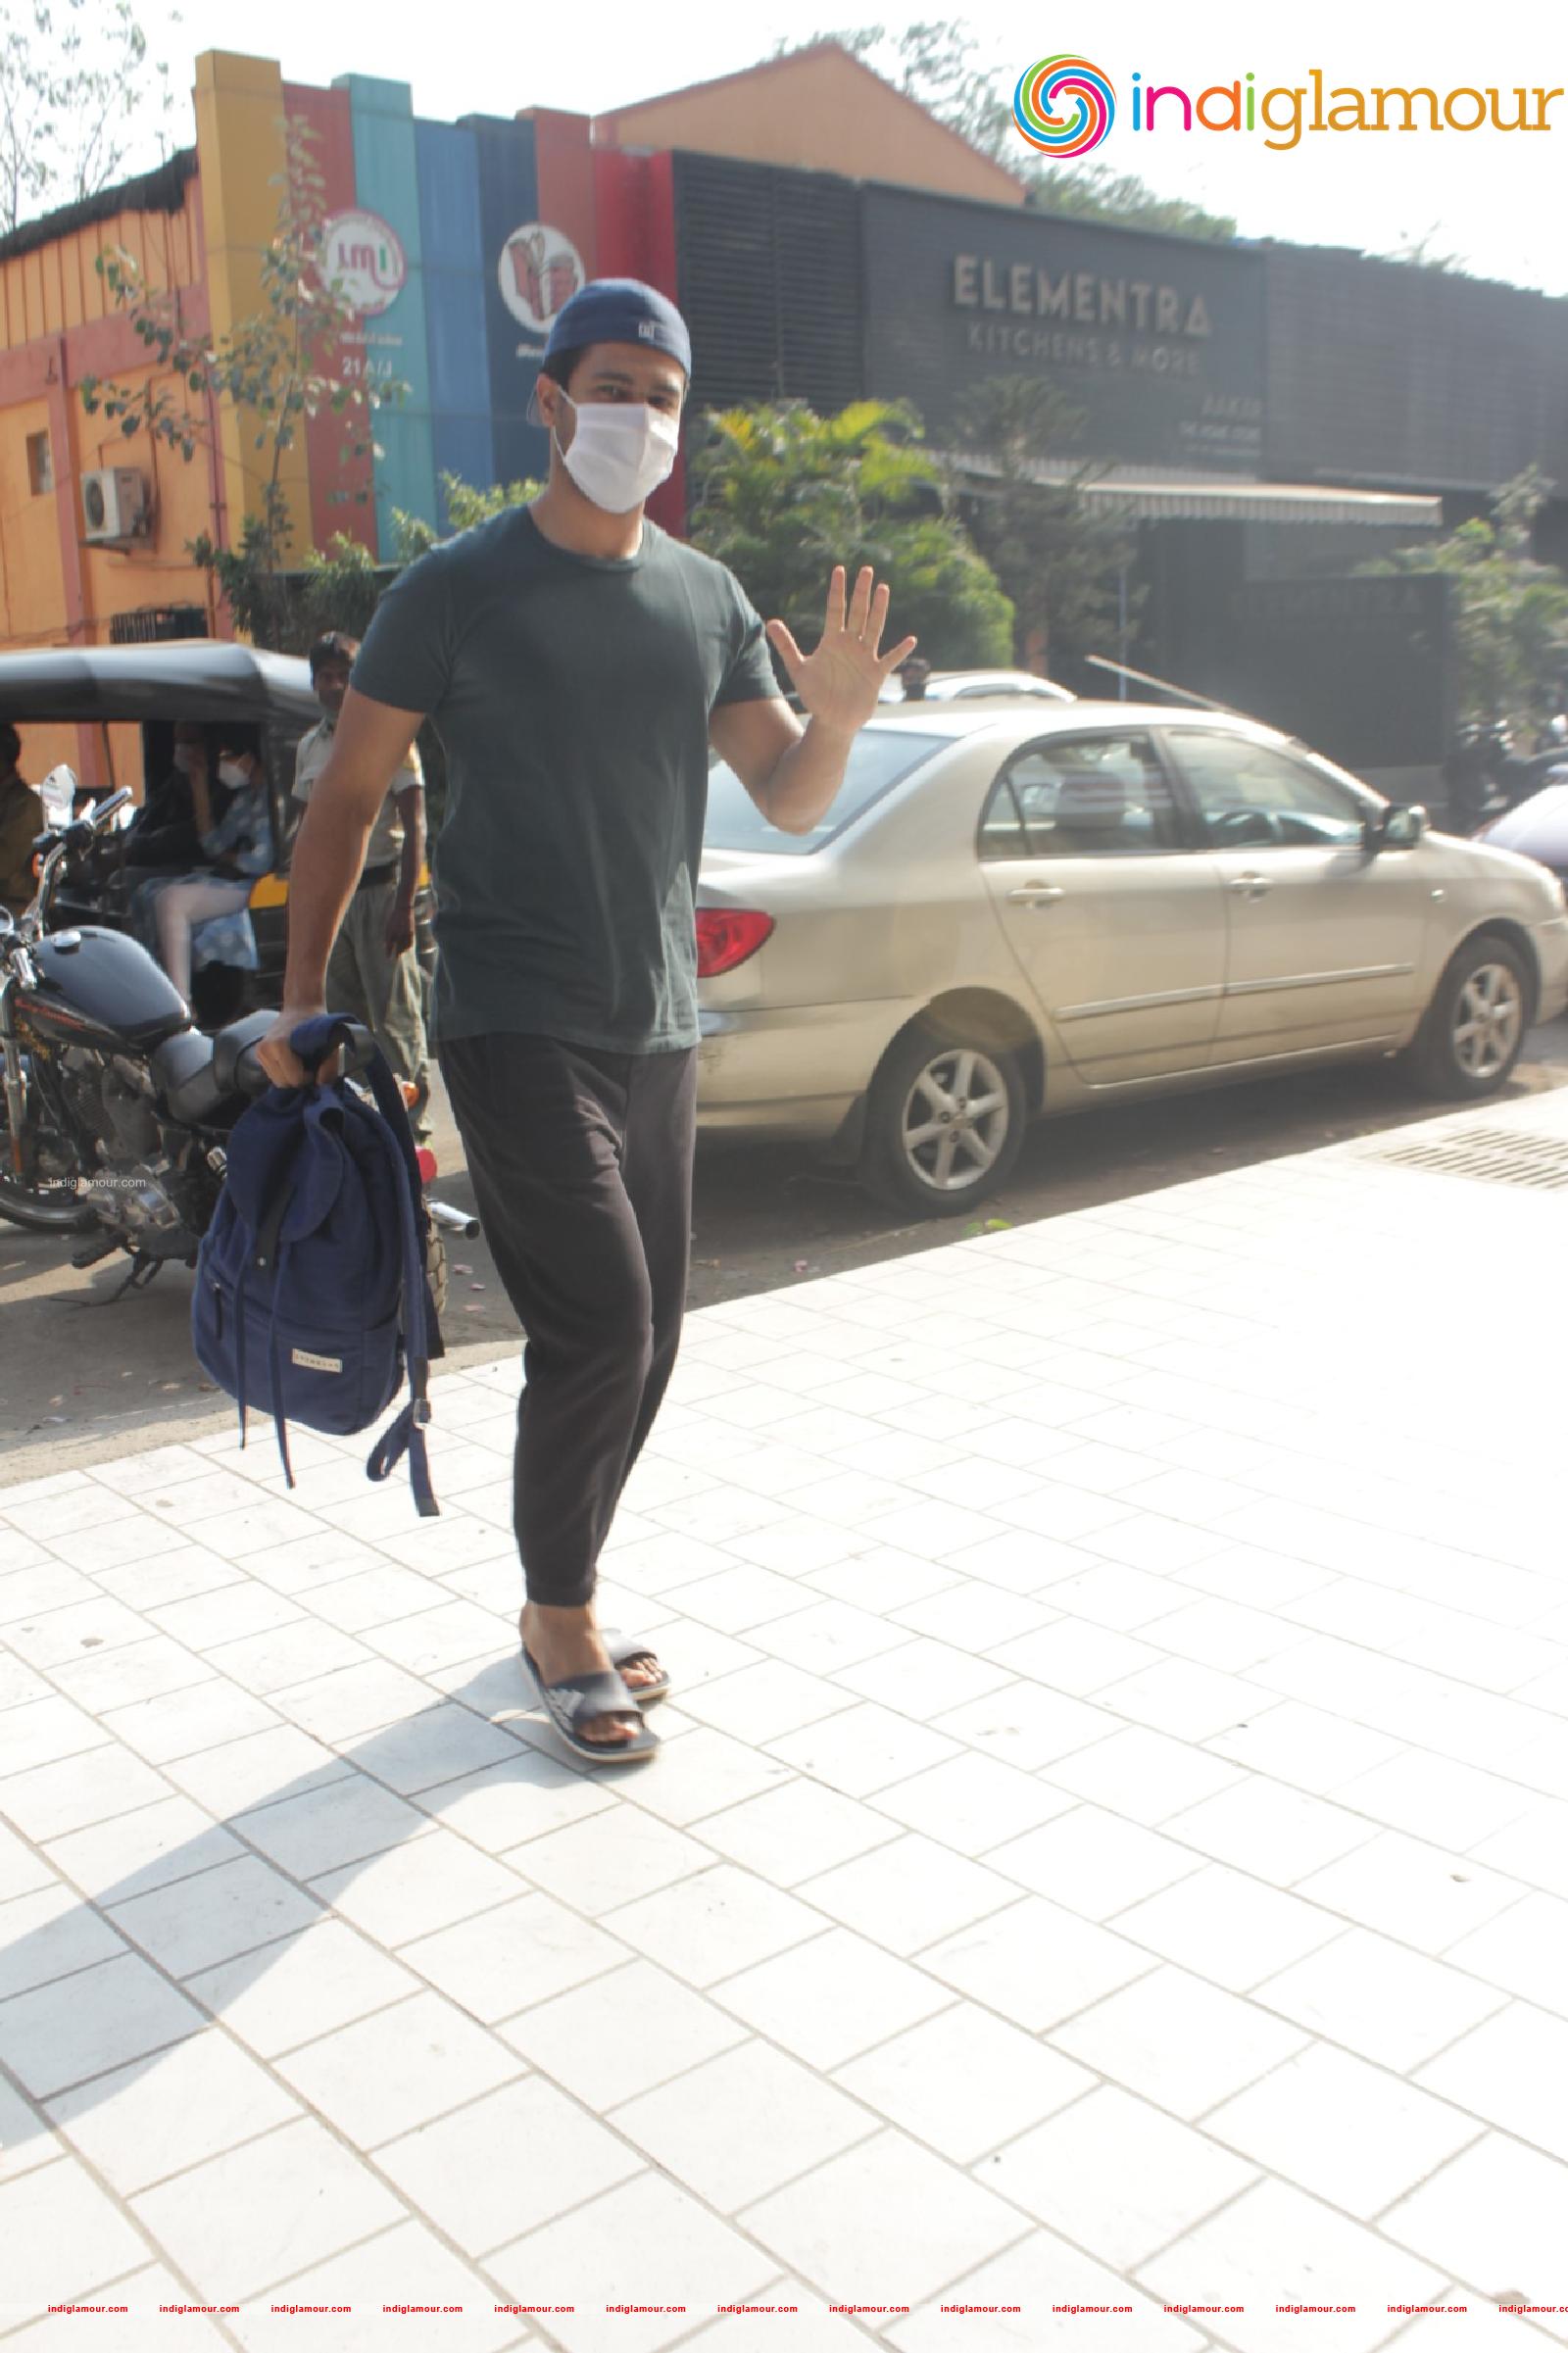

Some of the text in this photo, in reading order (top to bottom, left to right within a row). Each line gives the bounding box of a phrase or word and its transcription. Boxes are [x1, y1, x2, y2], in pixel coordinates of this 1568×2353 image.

[954, 254, 1213, 338] ELEMENTRA
[967, 321, 1100, 366] KITCHENS
[1131, 345, 1200, 376] MORE
